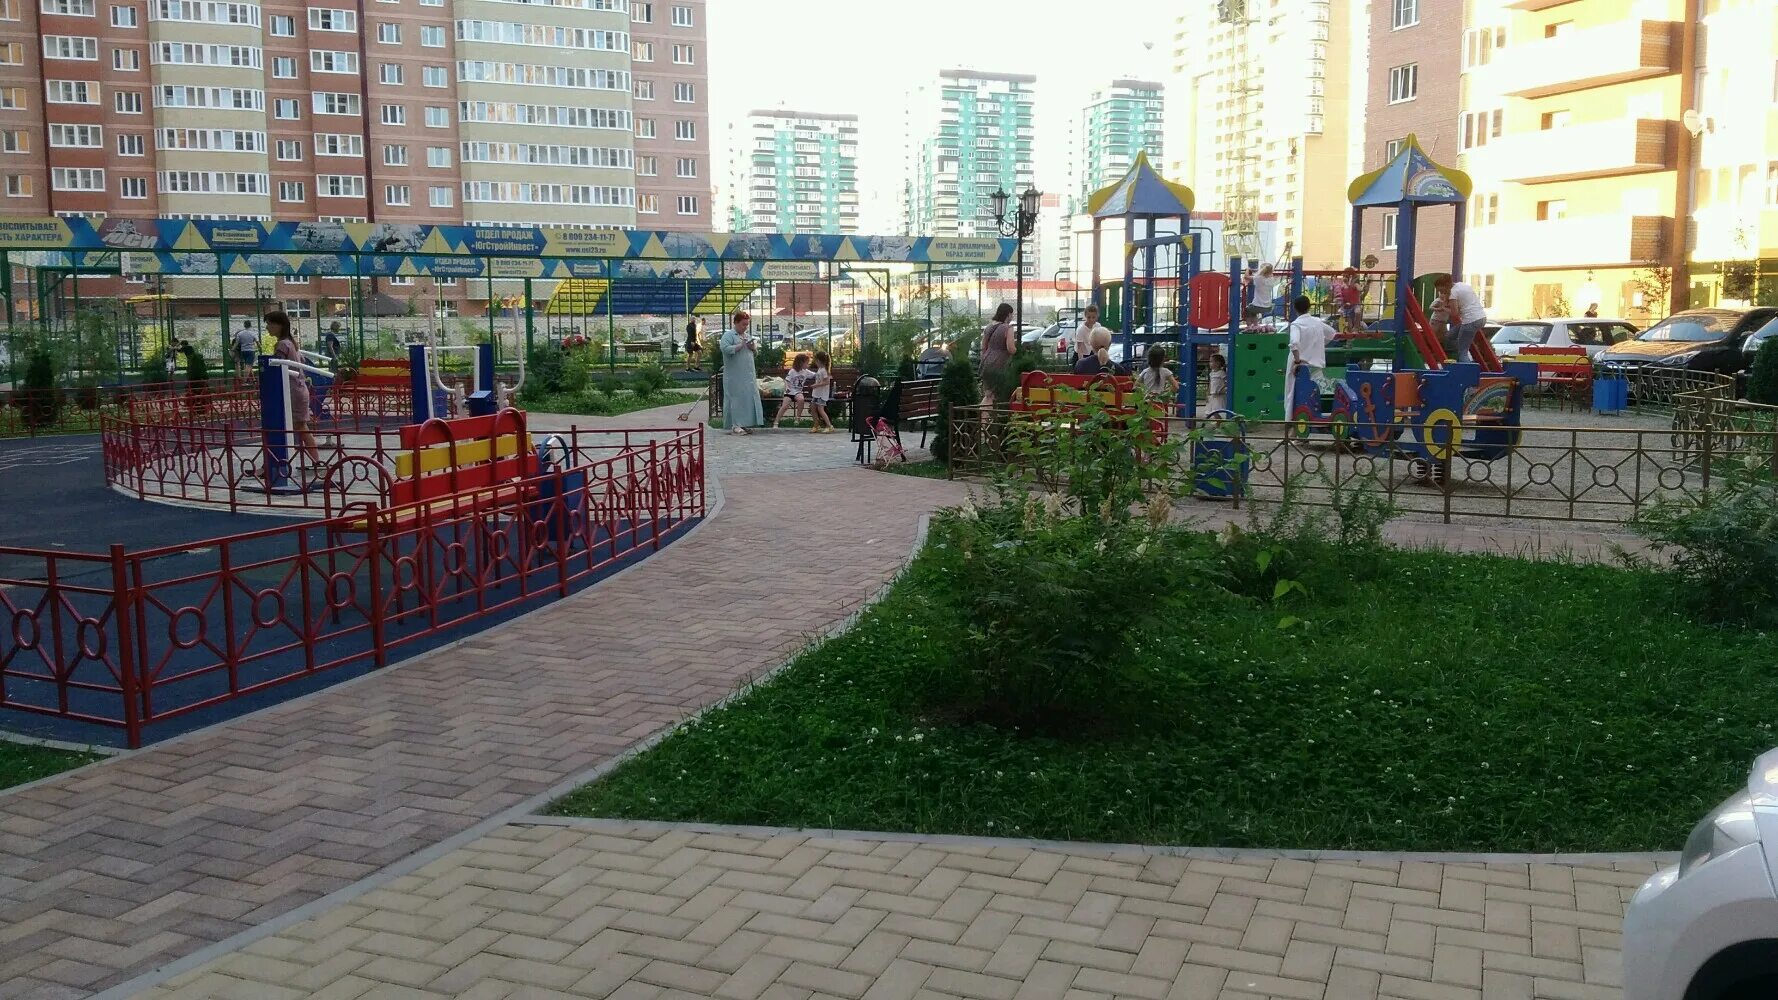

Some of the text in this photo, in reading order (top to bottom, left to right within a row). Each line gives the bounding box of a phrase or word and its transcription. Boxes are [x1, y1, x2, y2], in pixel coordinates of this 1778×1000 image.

[15, 233, 62, 241] ХАРАКТЕРА
[475, 229, 533, 240] ОТДЕЛ ПРОДАЖ
[568, 233, 583, 241] 800
[584, 233, 616, 241] 234-11-77
